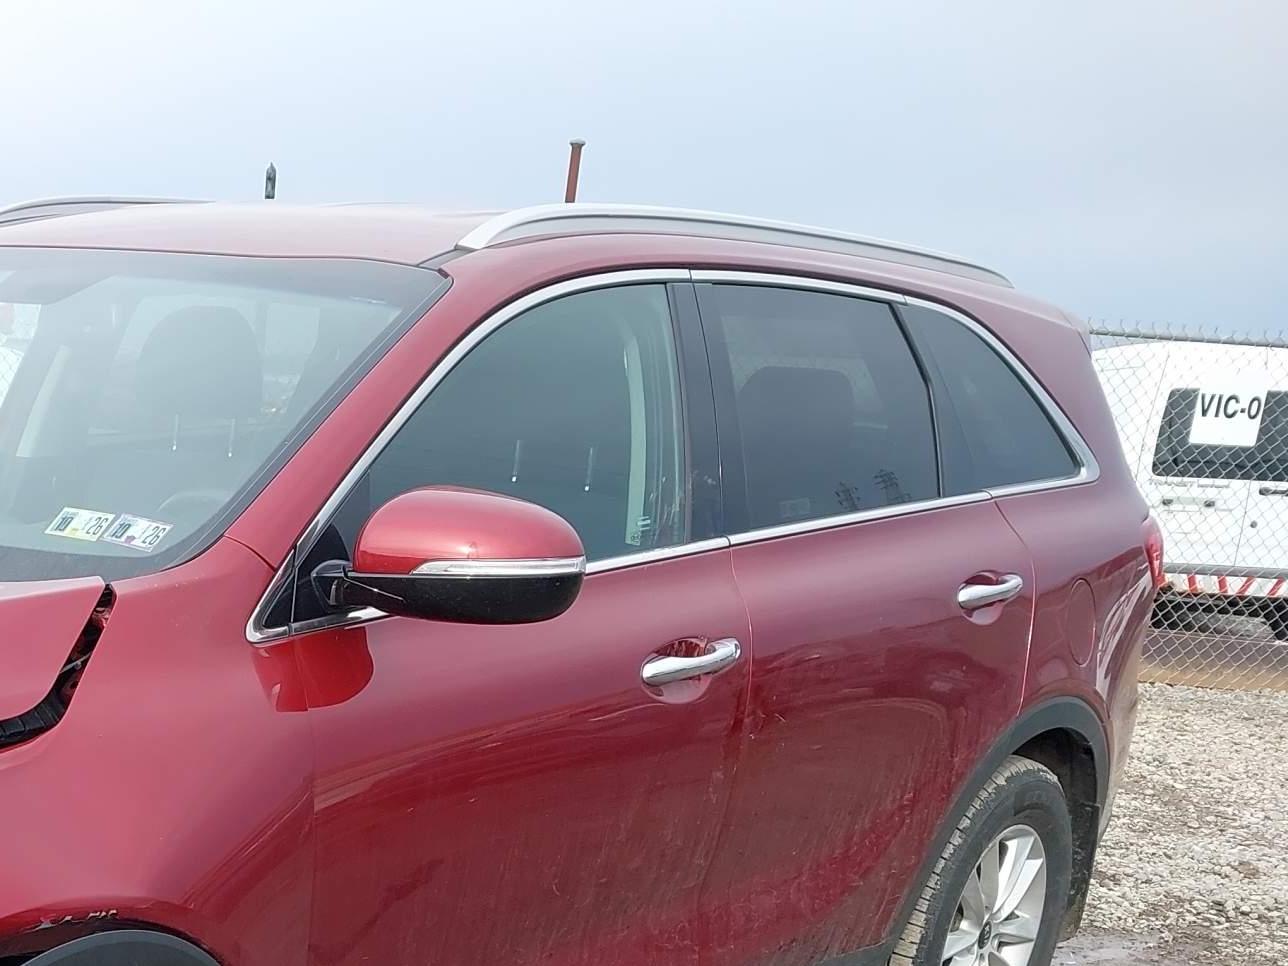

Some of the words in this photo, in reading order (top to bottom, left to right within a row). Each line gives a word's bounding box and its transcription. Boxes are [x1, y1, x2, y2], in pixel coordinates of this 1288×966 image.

[86, 515, 109, 536] 26
[111, 521, 132, 539] 10
[141, 525, 167, 546] 26
